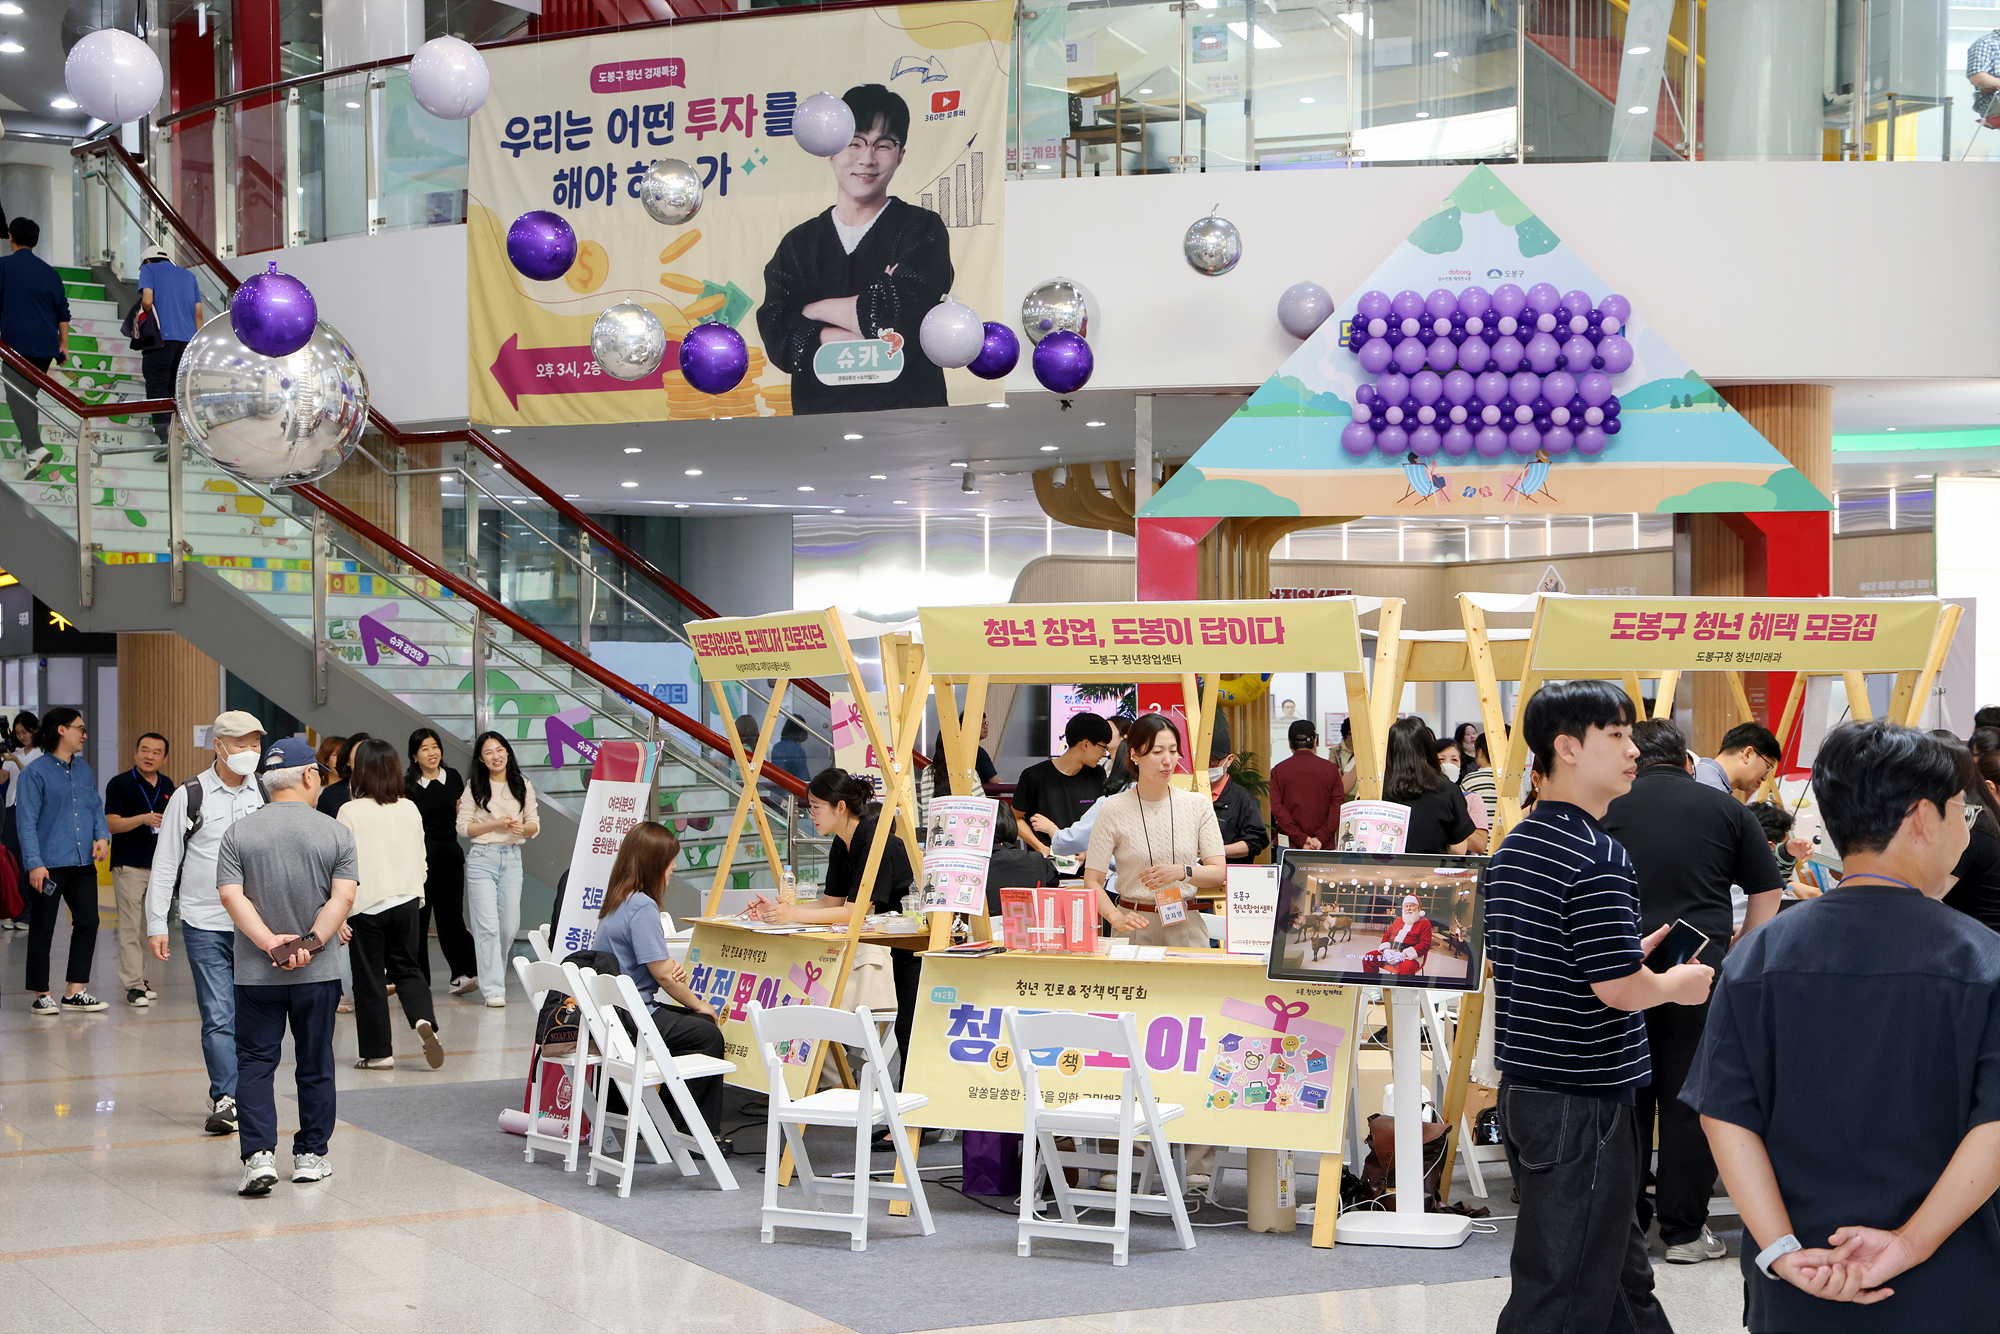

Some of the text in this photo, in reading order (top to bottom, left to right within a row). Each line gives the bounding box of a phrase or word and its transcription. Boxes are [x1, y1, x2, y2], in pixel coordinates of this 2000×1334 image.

[598, 65, 679, 83] 도봉구 청년 경제특강
[924, 109, 966, 122] 360만 유튜버
[500, 109, 593, 158] 우리는
[607, 101, 674, 149] 어떤
[553, 151, 732, 210] 해야 하가
[1505, 270, 1525, 278] 도봉구
[837, 345, 879, 369] 슈카
[536, 361, 602, 379] 오후 3시, 2층
[983, 616, 1285, 649] 청년 창업, 도봉이 답이다
[1609, 610, 1878, 642] 도봉구 청년 혜택 모음집
[389, 635, 405, 650] 슈카
[403, 642, 425, 662] 강연장
[692, 623, 828, 657] 진로취업상담, 프레디저 진로진단
[1089, 653, 1182, 665] 도봉구 청년창업센터
[1695, 651, 1782, 664] 도봉구청 청년미래과
[653, 683, 688, 704] 쉼터
[577, 740, 592, 755] 슈카
[608, 796, 636, 813] 여러분의
[598, 815, 614, 833] 성공
[582, 887, 604, 910] 진로
[1233, 891, 1250, 901] 도봉구
[1233, 903, 1273, 914] 청년창업센터
[933, 990, 955, 1000] 제2회
[1016, 979, 1039, 996] 청년
[995, 1050, 1009, 1068] 년
[1062, 1053, 1079, 1072] 책
[968, 1086, 1021, 1101] 알쏭달쏭한
[1057, 1091, 1079, 1104] 위한
